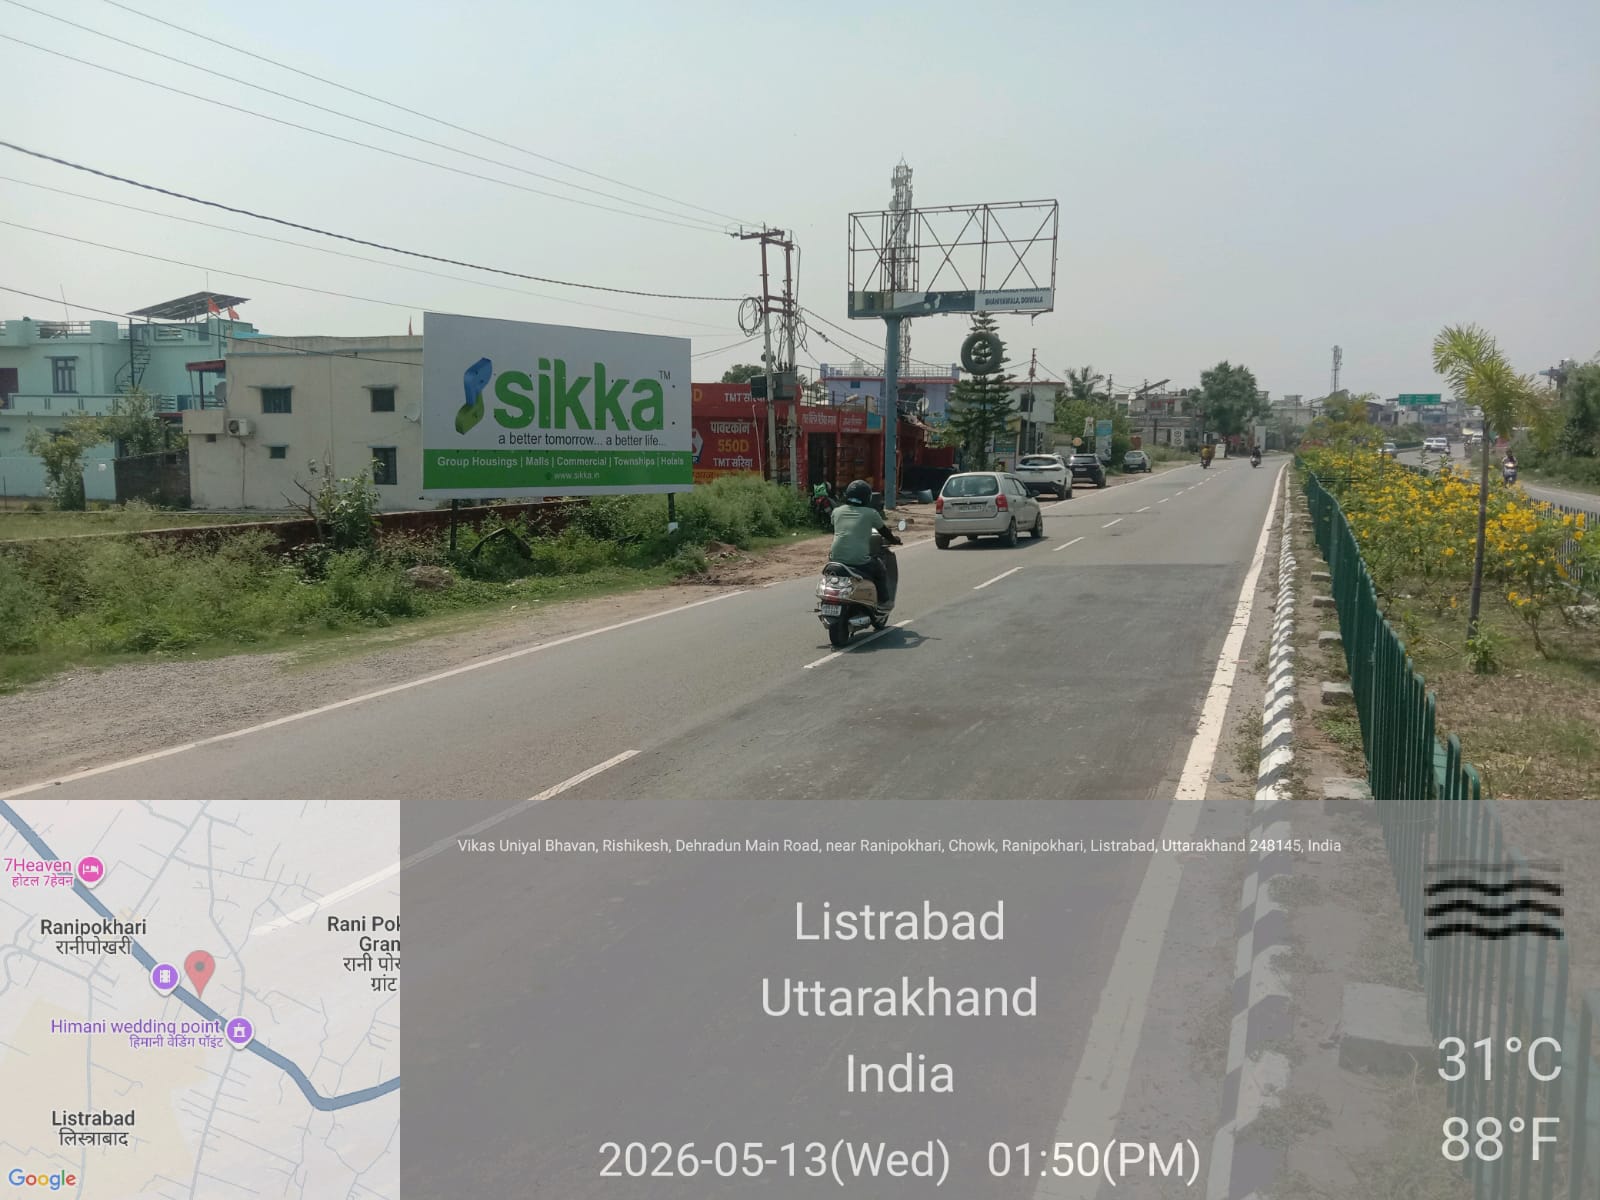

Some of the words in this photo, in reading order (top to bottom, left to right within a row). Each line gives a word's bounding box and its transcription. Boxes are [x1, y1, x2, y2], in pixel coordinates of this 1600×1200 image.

[493, 357, 664, 431] sikka
[498, 434, 506, 445] a
[509, 432, 542, 445] better
[545, 433, 603, 446] tomorrow...
[606, 436, 612, 446] a
[615, 434, 642, 446] better
[718, 439, 749, 453] 550D
[437, 456, 469, 468] Group
[472, 456, 518, 469] Housings
[525, 456, 550, 467] Malls
[556, 456, 607, 467] Commercial
[614, 456, 655, 468] Townships
[713, 457, 730, 467] TMT
